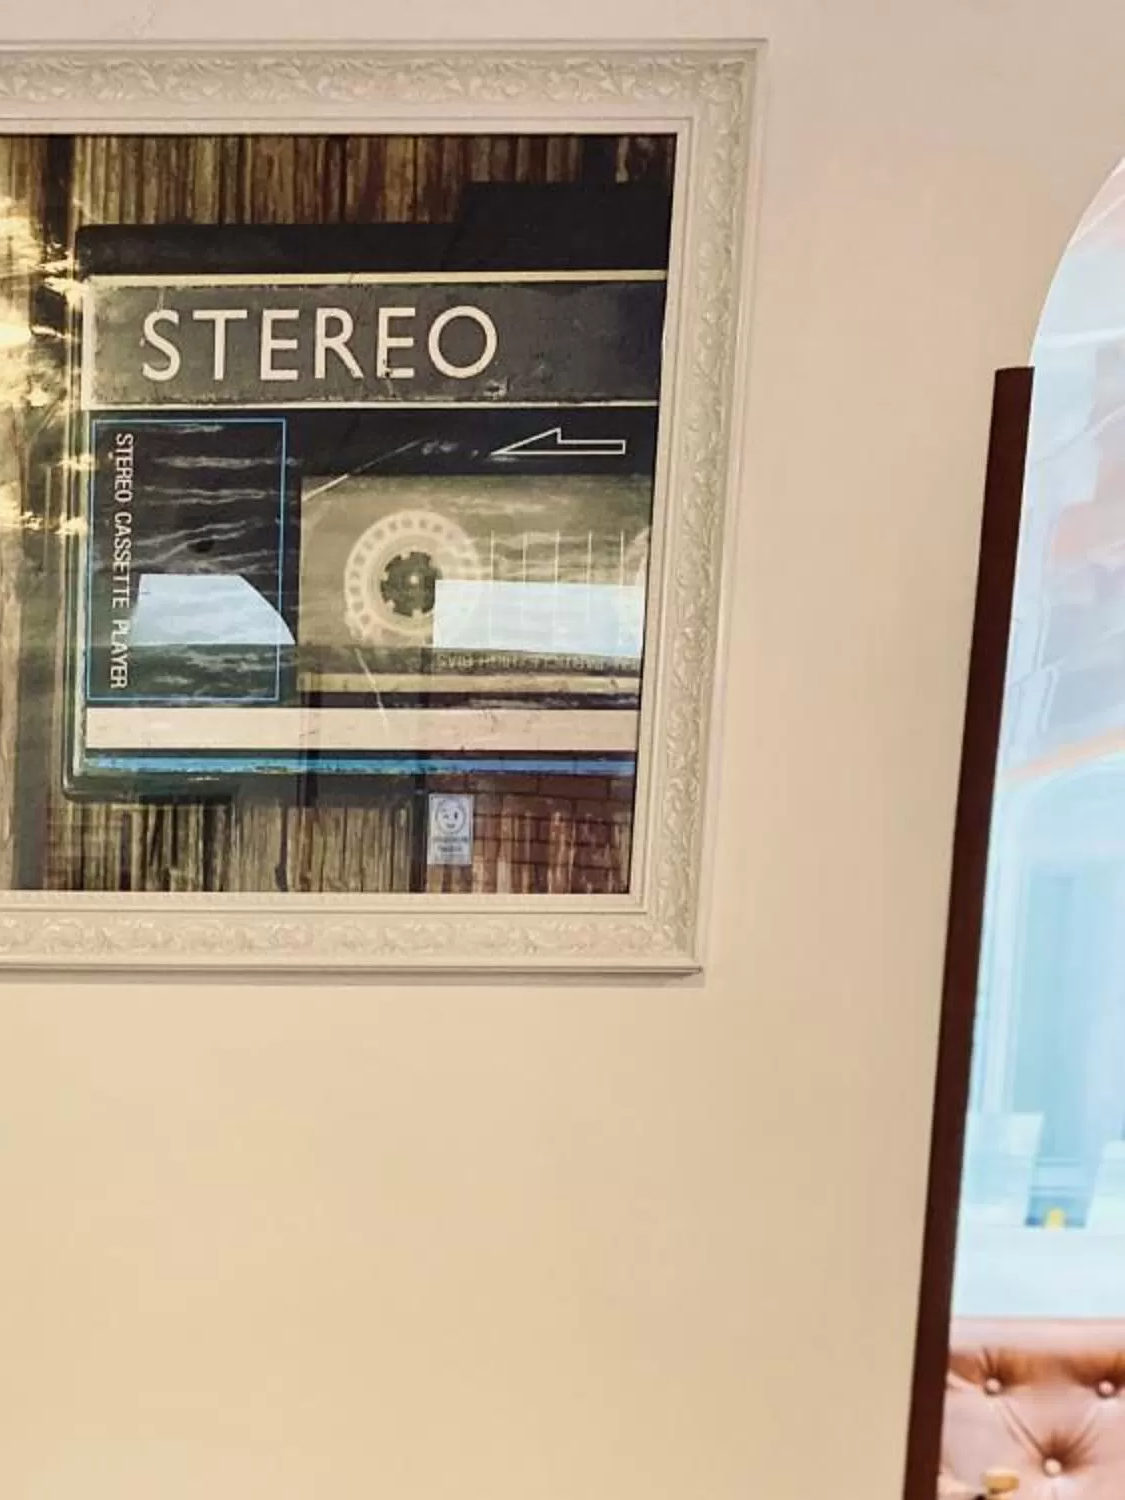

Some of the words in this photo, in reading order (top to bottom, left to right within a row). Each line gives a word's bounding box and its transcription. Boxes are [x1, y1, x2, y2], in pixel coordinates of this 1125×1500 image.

[141, 305, 498, 382] STEREO
[114, 433, 133, 503] STEREO
[112, 511, 132, 609] CASSETTE
[110, 619, 130, 689] PLAYER
